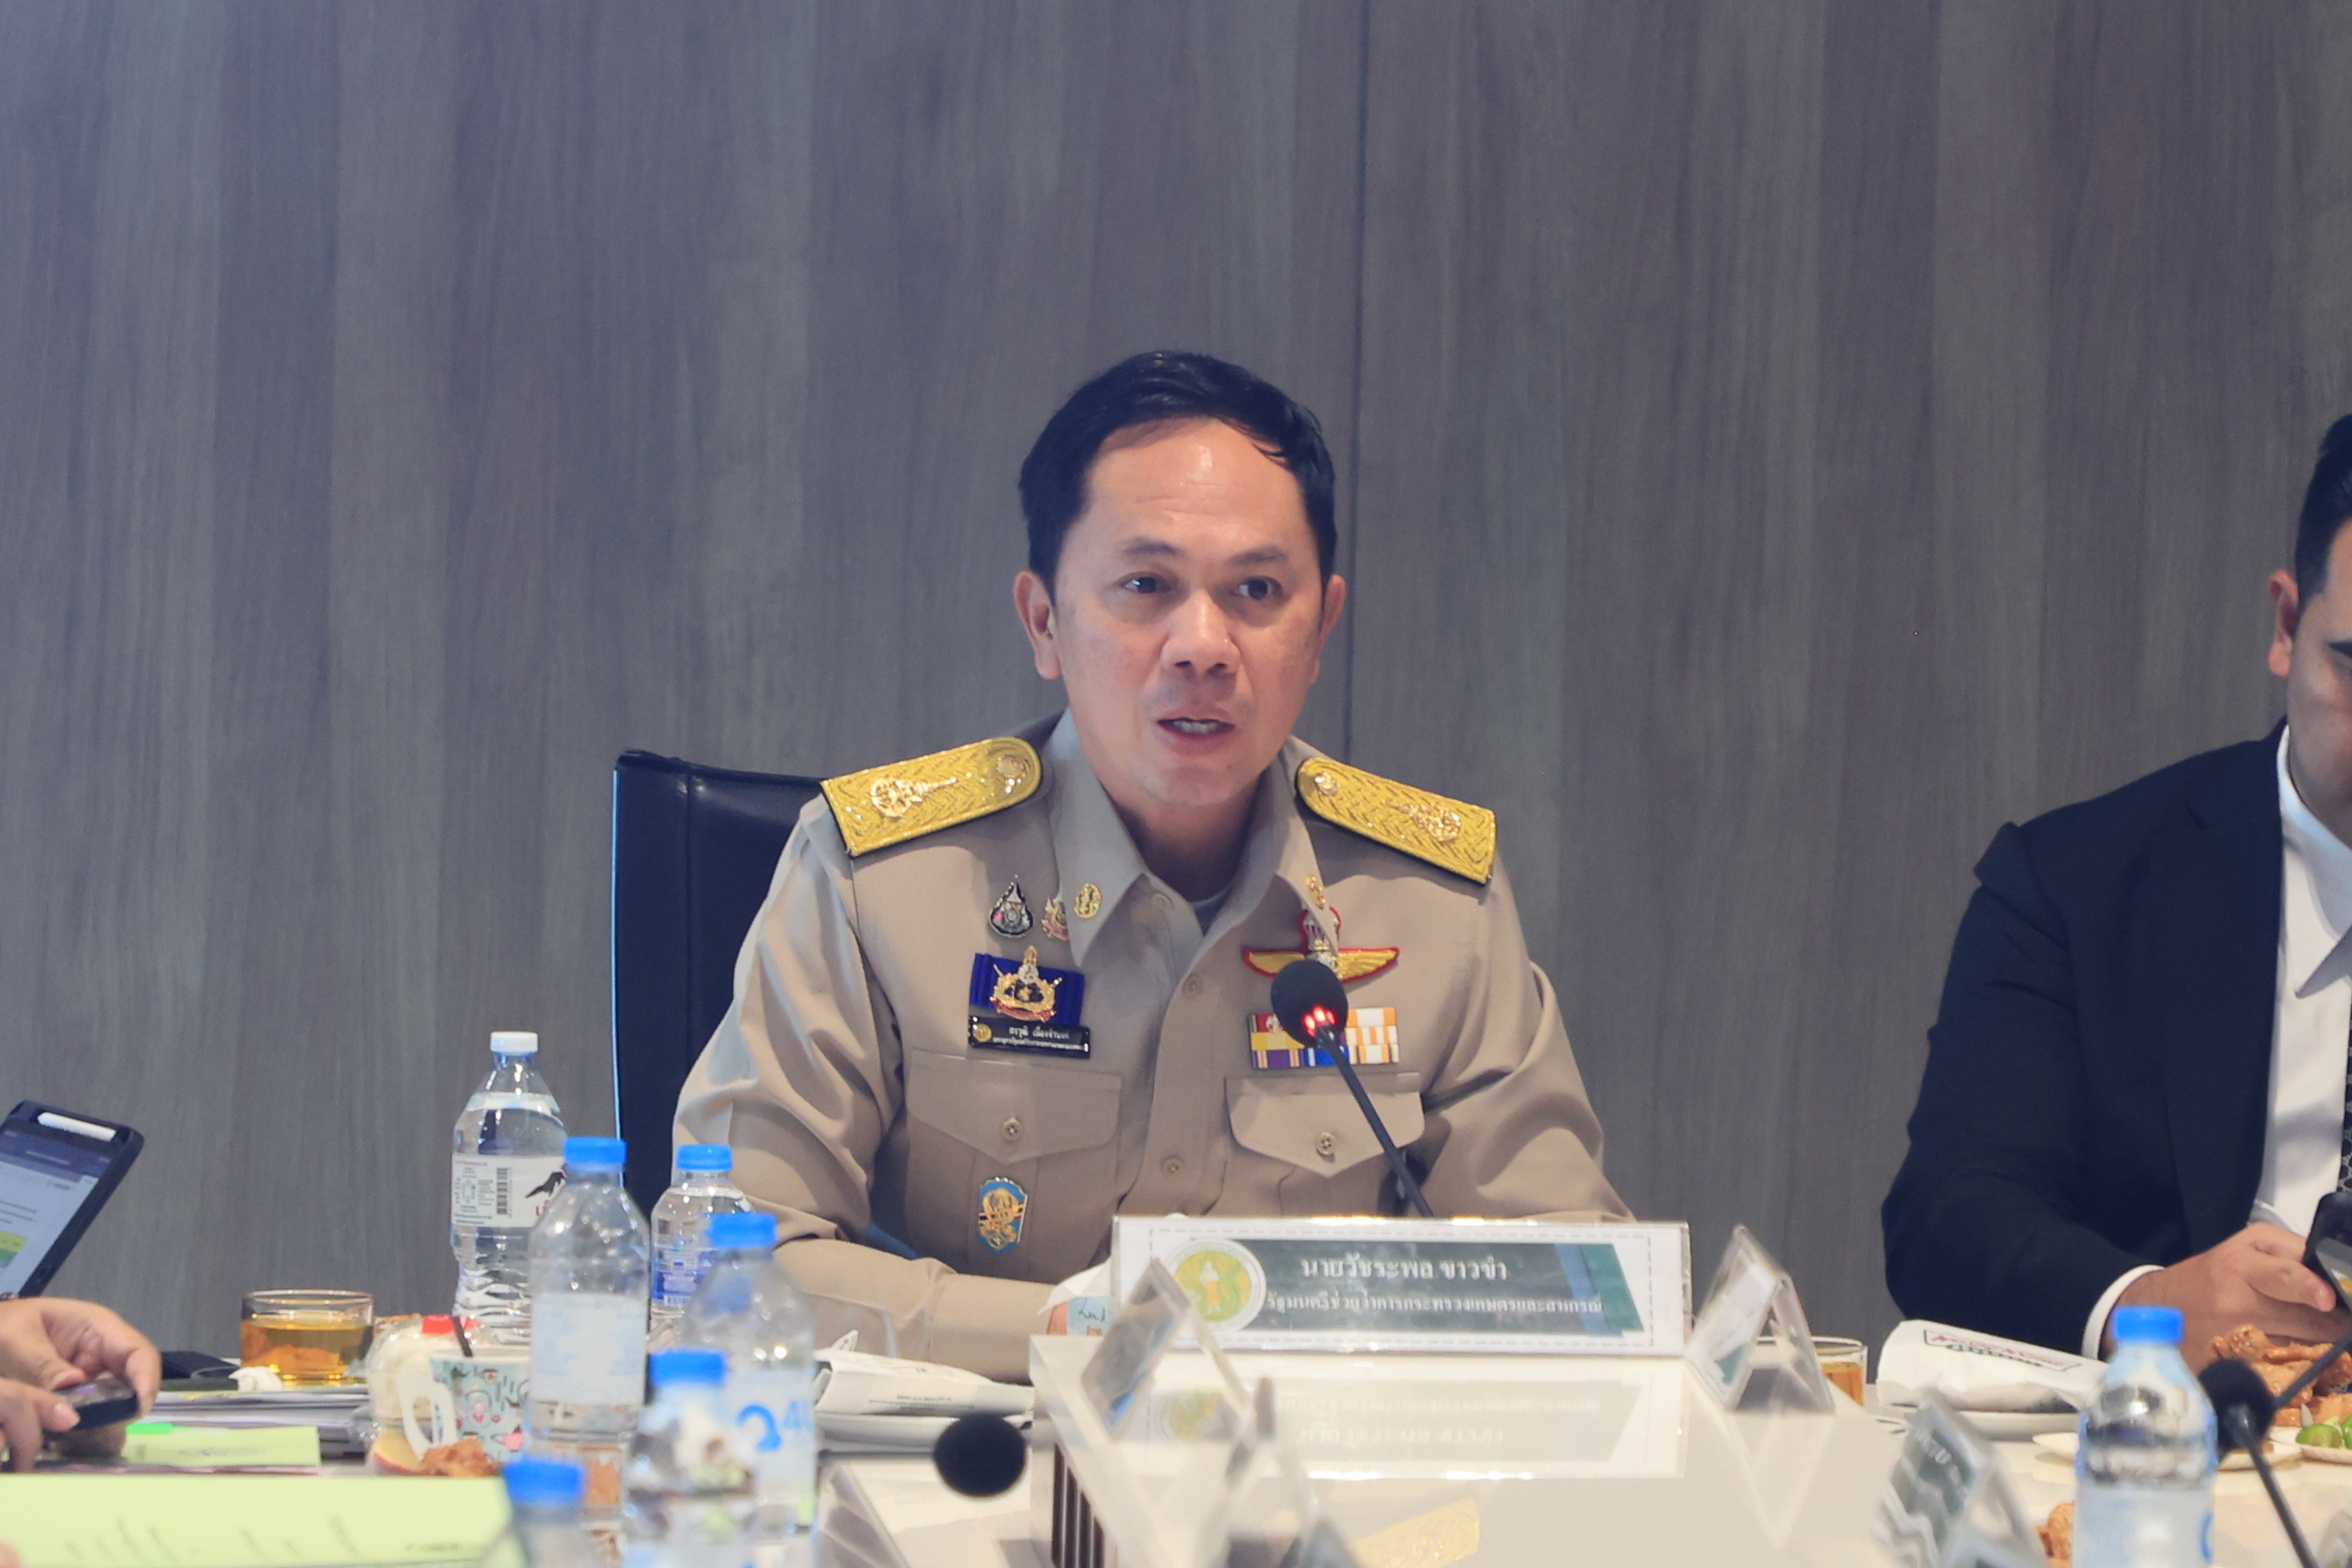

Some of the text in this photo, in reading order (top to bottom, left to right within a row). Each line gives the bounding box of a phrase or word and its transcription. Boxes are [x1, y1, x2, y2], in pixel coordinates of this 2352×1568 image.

[1301, 1252, 1508, 1280] นายวัชระพล ขาวขำ
